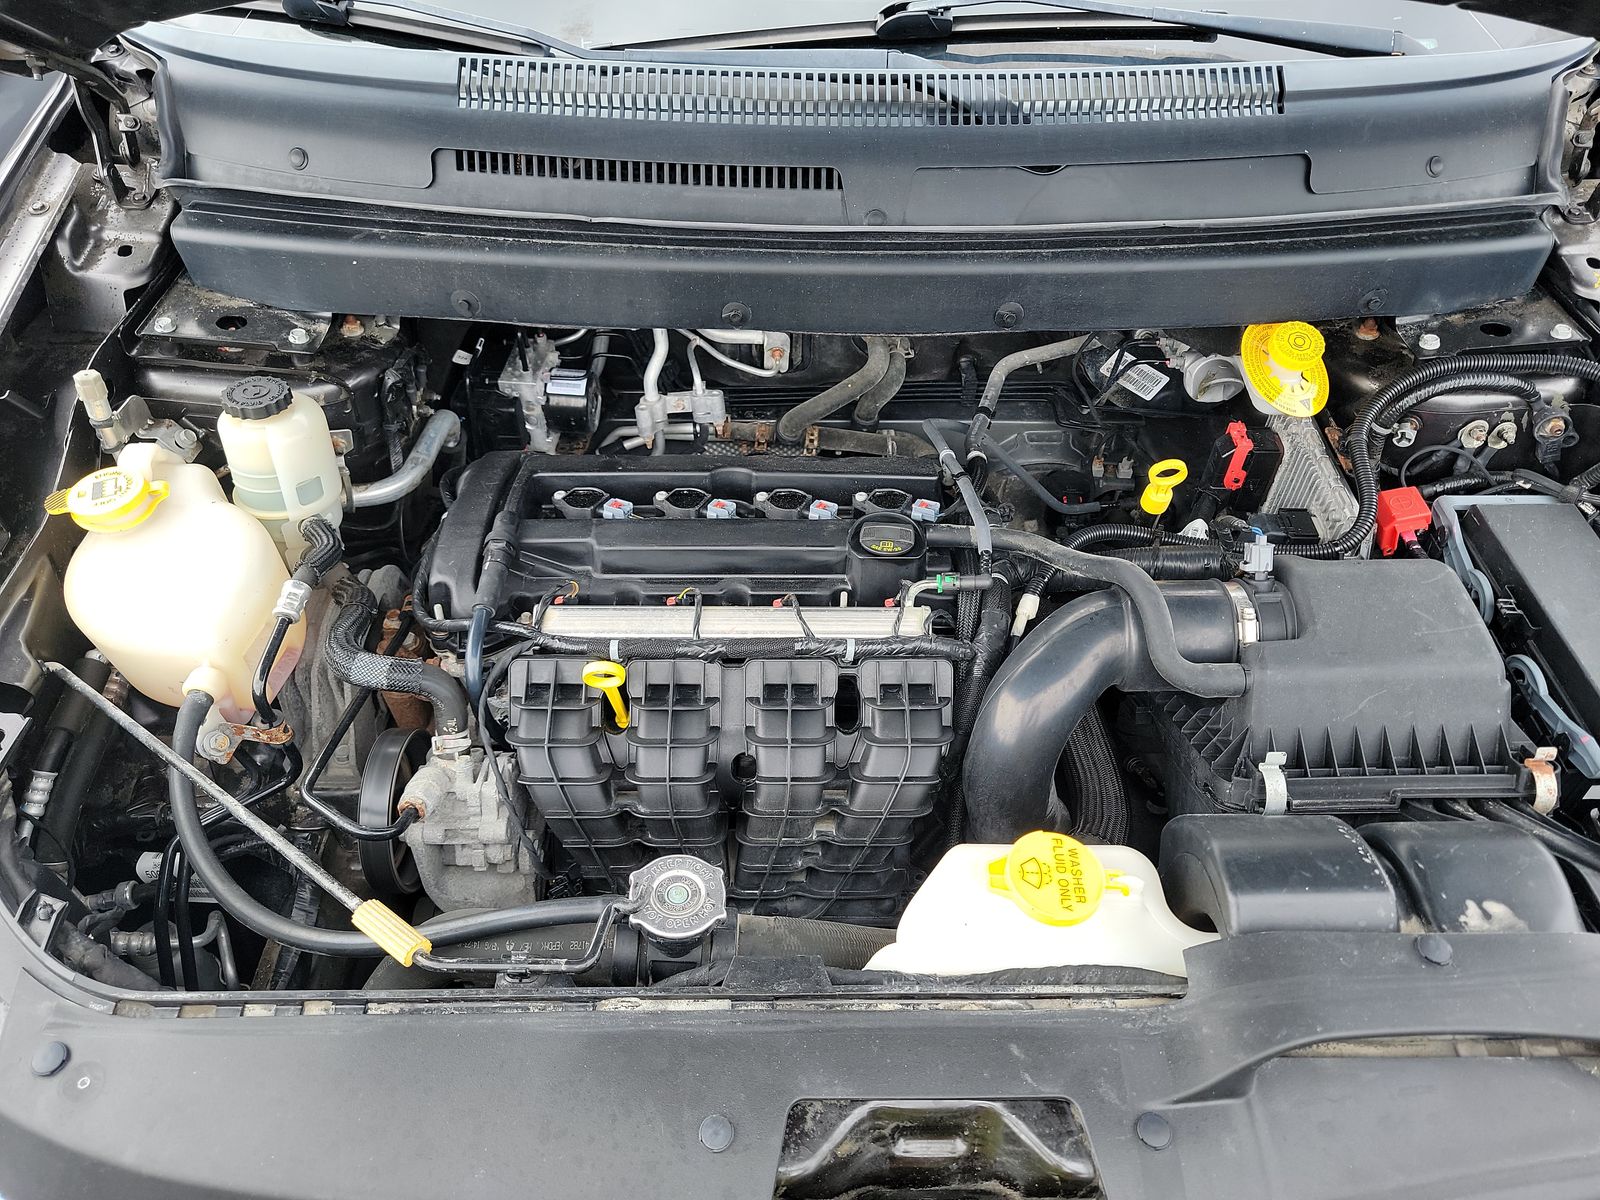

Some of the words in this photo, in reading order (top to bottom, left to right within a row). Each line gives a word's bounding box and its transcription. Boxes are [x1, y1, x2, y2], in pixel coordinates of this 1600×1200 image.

[651, 858, 682, 875] KEEP
[686, 860, 714, 881] TIGHT
[1051, 838, 1066, 874] FLUID
[1068, 848, 1087, 904] WASHER
[1057, 878, 1074, 912] ONLY
[666, 916, 699, 928] OPEN
[699, 897, 716, 918] HOT
